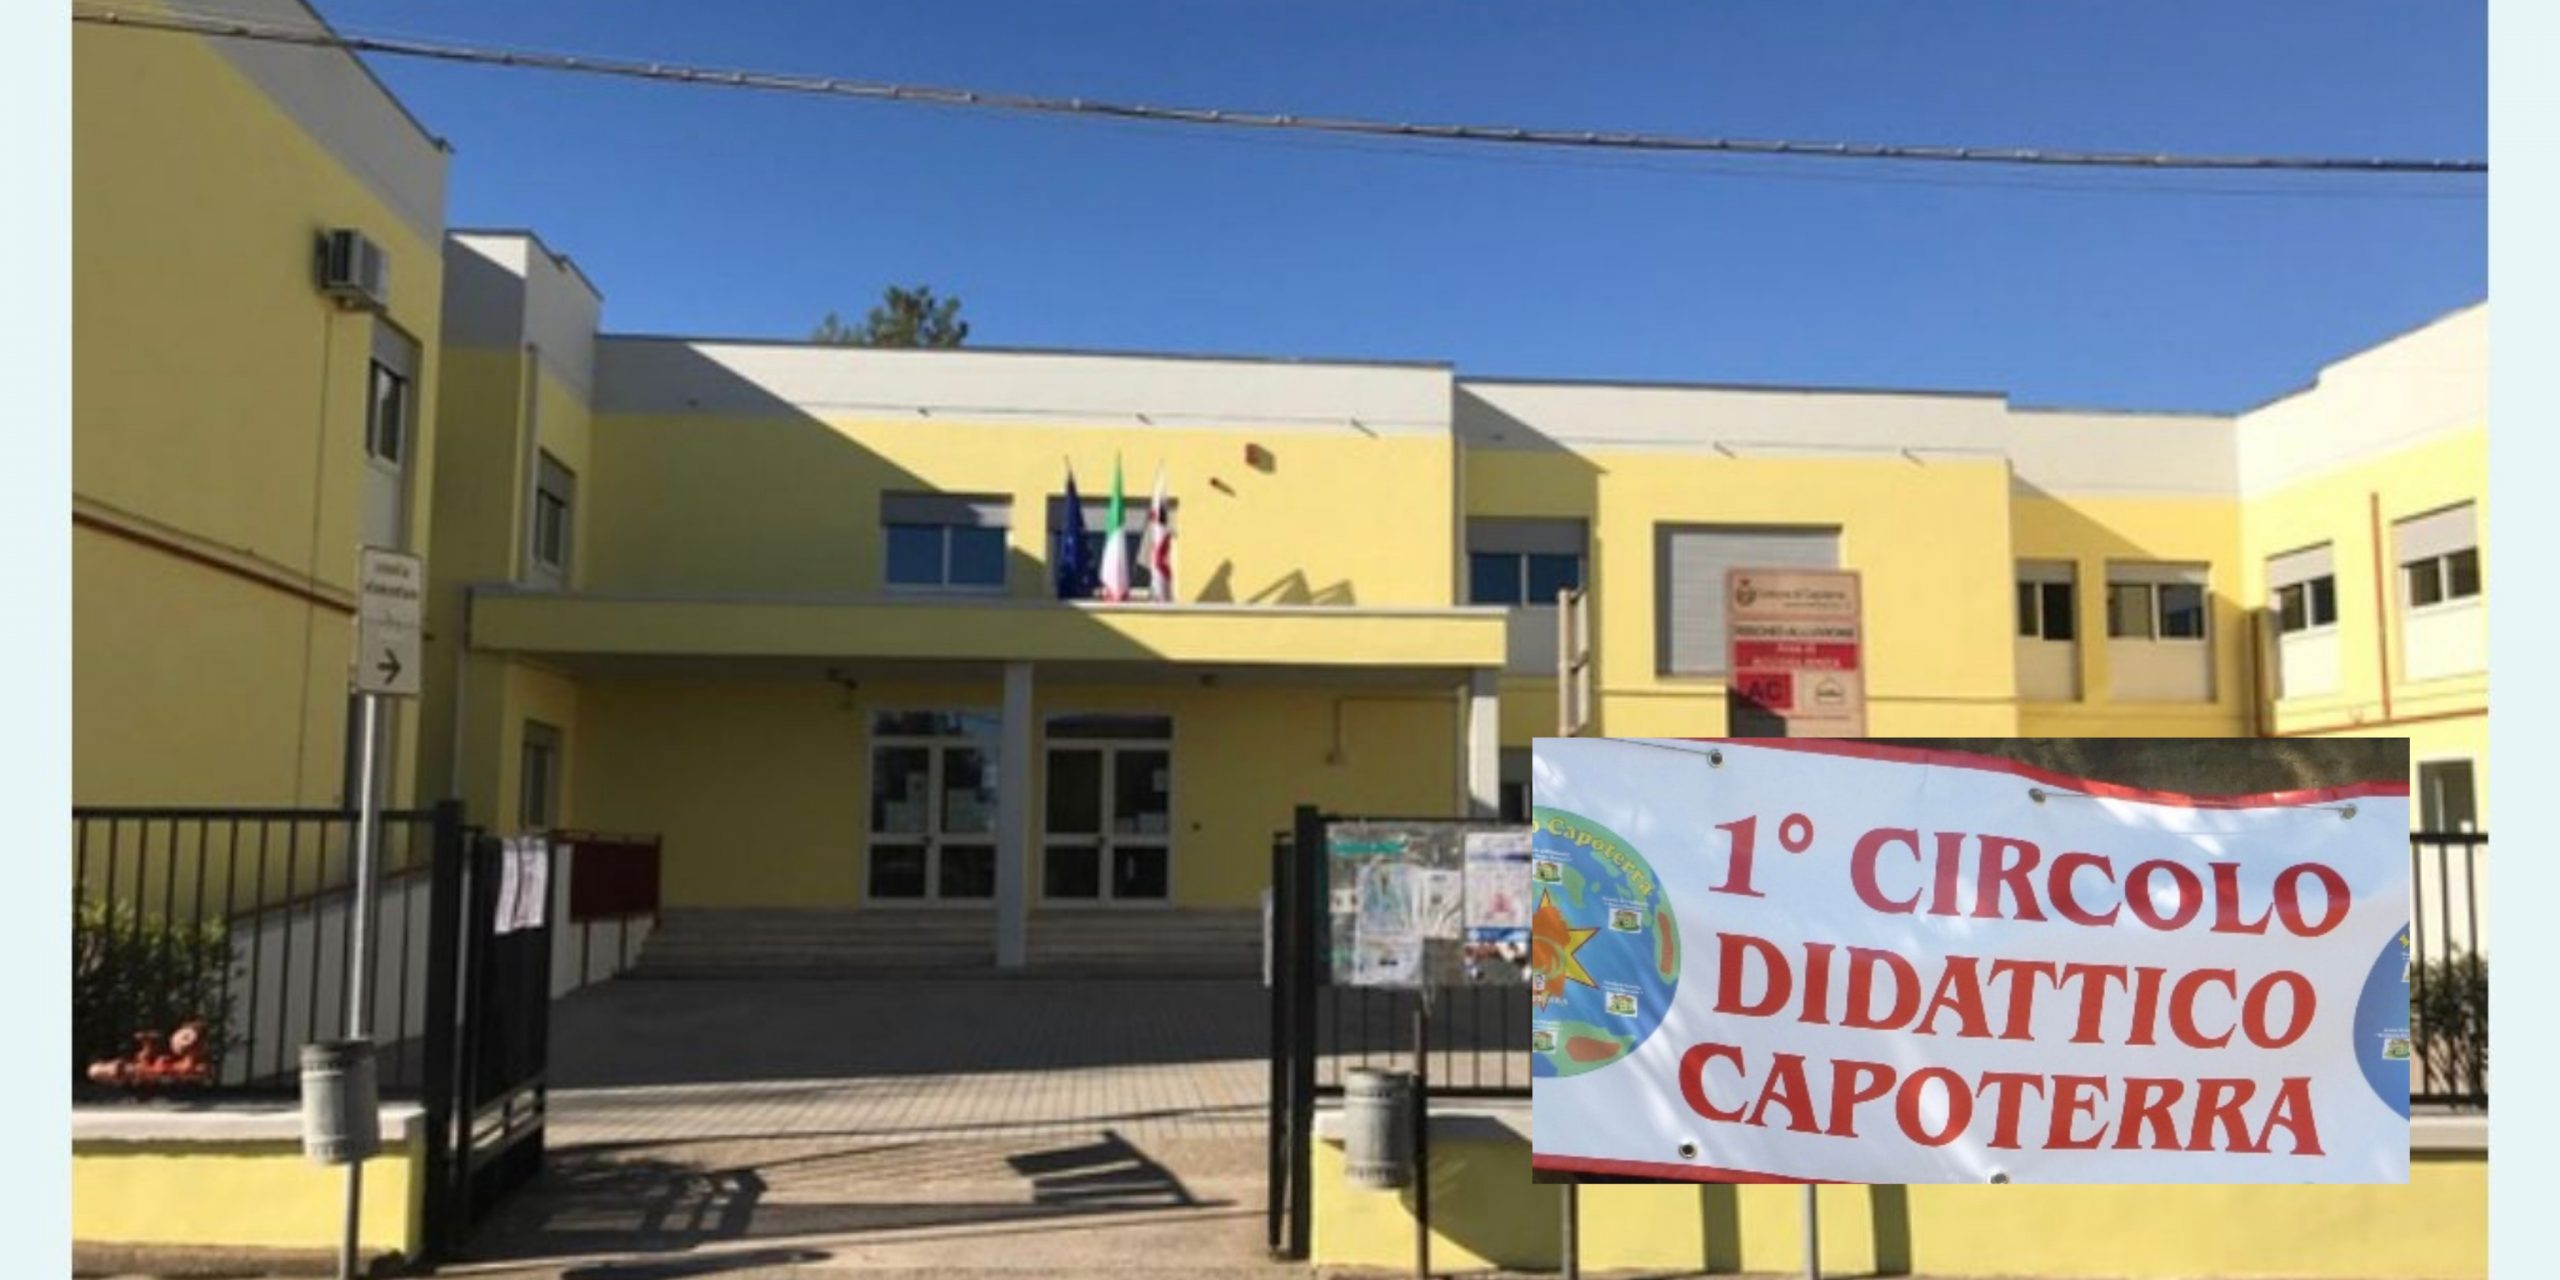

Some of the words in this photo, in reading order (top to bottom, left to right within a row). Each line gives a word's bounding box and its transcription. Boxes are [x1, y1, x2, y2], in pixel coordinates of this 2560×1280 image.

[1547, 816, 1653, 896] Capoterra
[1709, 813, 1813, 898] 1°
[1851, 826, 2351, 938] CIRCOLO
[1712, 932, 2317, 1050] DIDATTICO
[1678, 1042, 2326, 1158] CAPOTERRA
